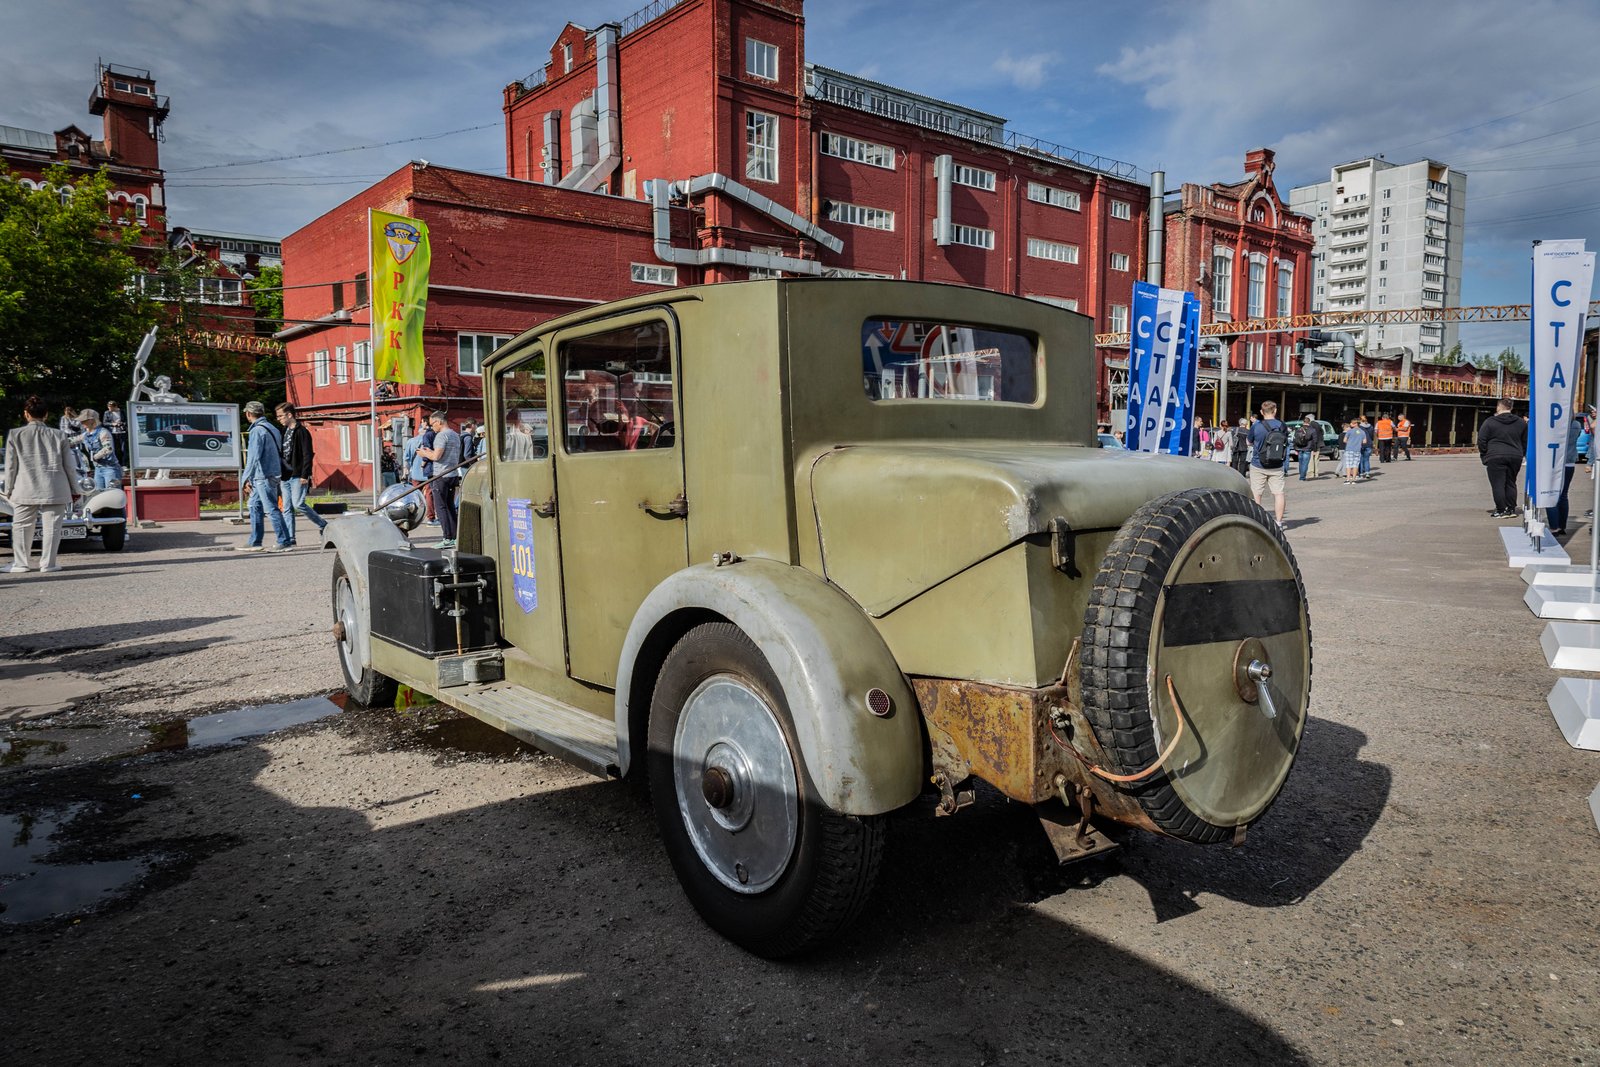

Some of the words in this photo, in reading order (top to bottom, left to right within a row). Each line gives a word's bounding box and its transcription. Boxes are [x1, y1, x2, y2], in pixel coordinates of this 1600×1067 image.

[390, 271, 404, 377] РККА
[1548, 280, 1572, 468] СТАРТ
[1142, 321, 1174, 453] СТАР
[512, 544, 534, 578] 101
